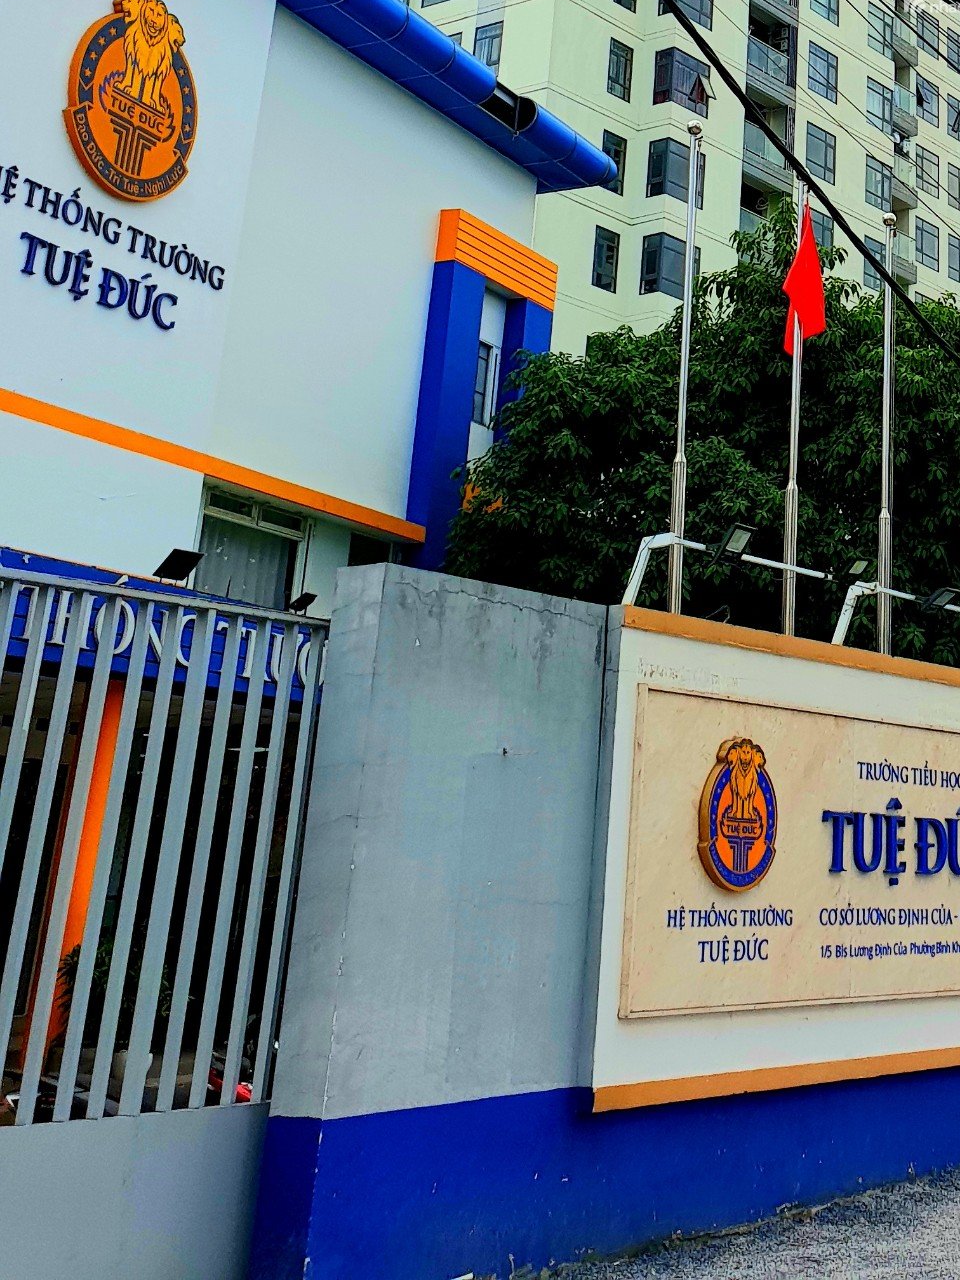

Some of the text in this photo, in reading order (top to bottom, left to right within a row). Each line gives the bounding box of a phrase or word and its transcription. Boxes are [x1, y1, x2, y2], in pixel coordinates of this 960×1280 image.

[139, 111, 165, 134] ĐỨC
[0, 165, 225, 291] Ệ THỐNG TRƯỜNG
[20, 231, 178, 330] TUỆ ĐỨC
[857, 759, 908, 784] TRƯỜNG
[911, 760, 938, 786] TIỂU
[822, 797, 906, 886] TUỆ
[667, 902, 793, 930] HỆ THỐNG TRƯỜNG
[819, 907, 838, 926] CƠ
[839, 902, 854, 926] SỞ
[856, 906, 896, 926] LƯƠNG
[898, 908, 929, 928] ĐỊNH
[931, 904, 953, 926] CỦA
[698, 933, 769, 965] TUỆ ĐỨC
[821, 944, 832, 958] 1/5
[850, 944, 873, 960] Lương
[875, 942, 892, 959] Định
[893, 941, 908, 955] Của
